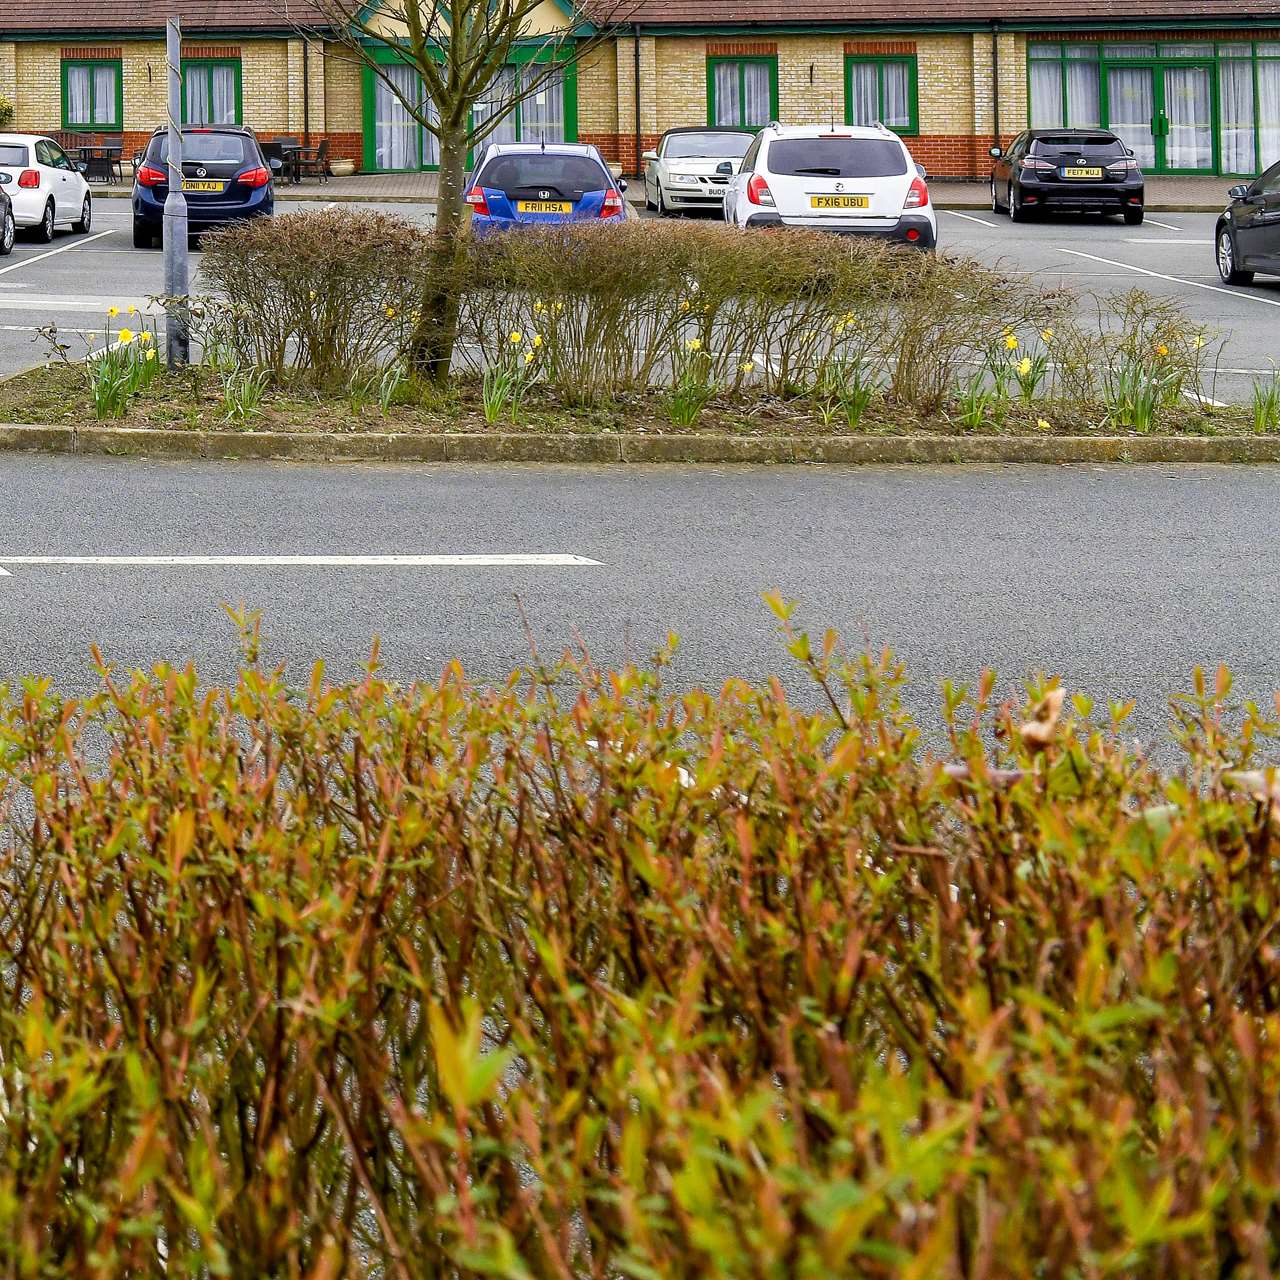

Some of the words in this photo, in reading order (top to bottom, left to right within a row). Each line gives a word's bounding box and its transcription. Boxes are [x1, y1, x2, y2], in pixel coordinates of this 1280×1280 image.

[524, 202, 542, 211] FR11
[544, 203, 563, 212] HSA
[817, 197, 840, 206] FX16
[843, 198, 863, 207] UBU
